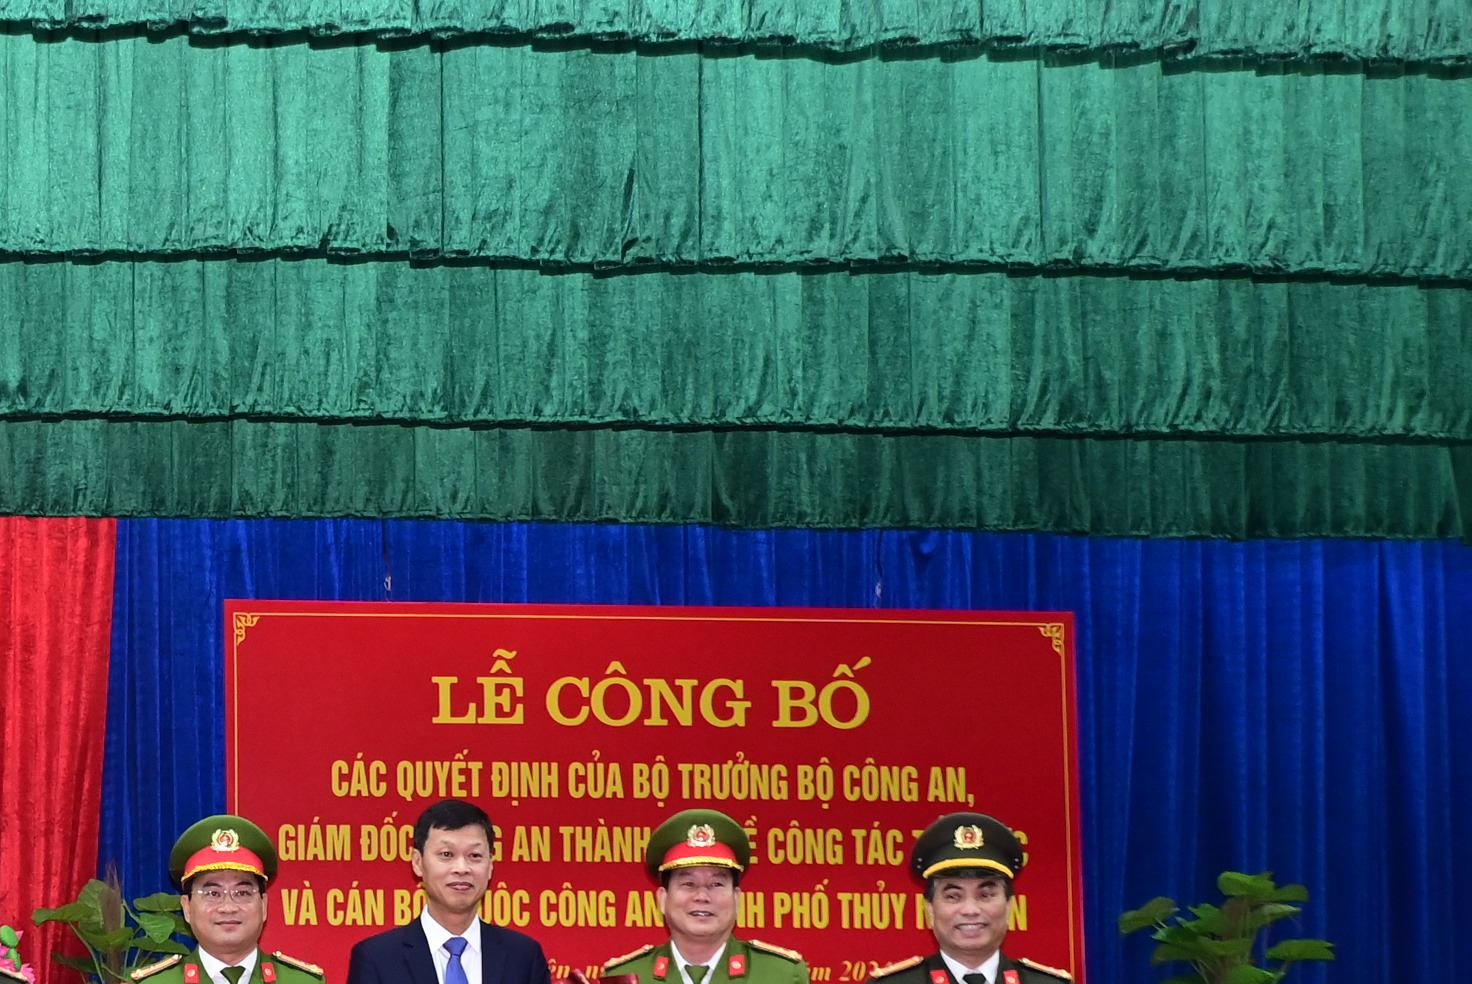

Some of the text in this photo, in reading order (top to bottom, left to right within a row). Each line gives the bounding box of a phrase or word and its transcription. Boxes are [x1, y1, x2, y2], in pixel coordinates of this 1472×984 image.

[432, 649, 872, 729] LỄ CÔNG BỐ
[331, 750, 974, 809] CÁC QUYẾT ĐỊNH CỦA BỘ TRƯỞNG BỘ CÔNG AN,
[278, 817, 351, 861] GIÁM
[360, 811, 415, 861] ĐỐC
[511, 826, 551, 861] AN
[559, 819, 651, 863] THÀNH
[768, 820, 843, 864] CÔNG
[851, 822, 904, 866] TÁC
[281, 881, 318, 926] VÀ
[327, 881, 385, 926] CÁN
[540, 882, 617, 927] CÔNG
[625, 891, 665, 927] AN
[774, 880, 830, 928] PHỐ
[837, 881, 907, 930] THỦY
